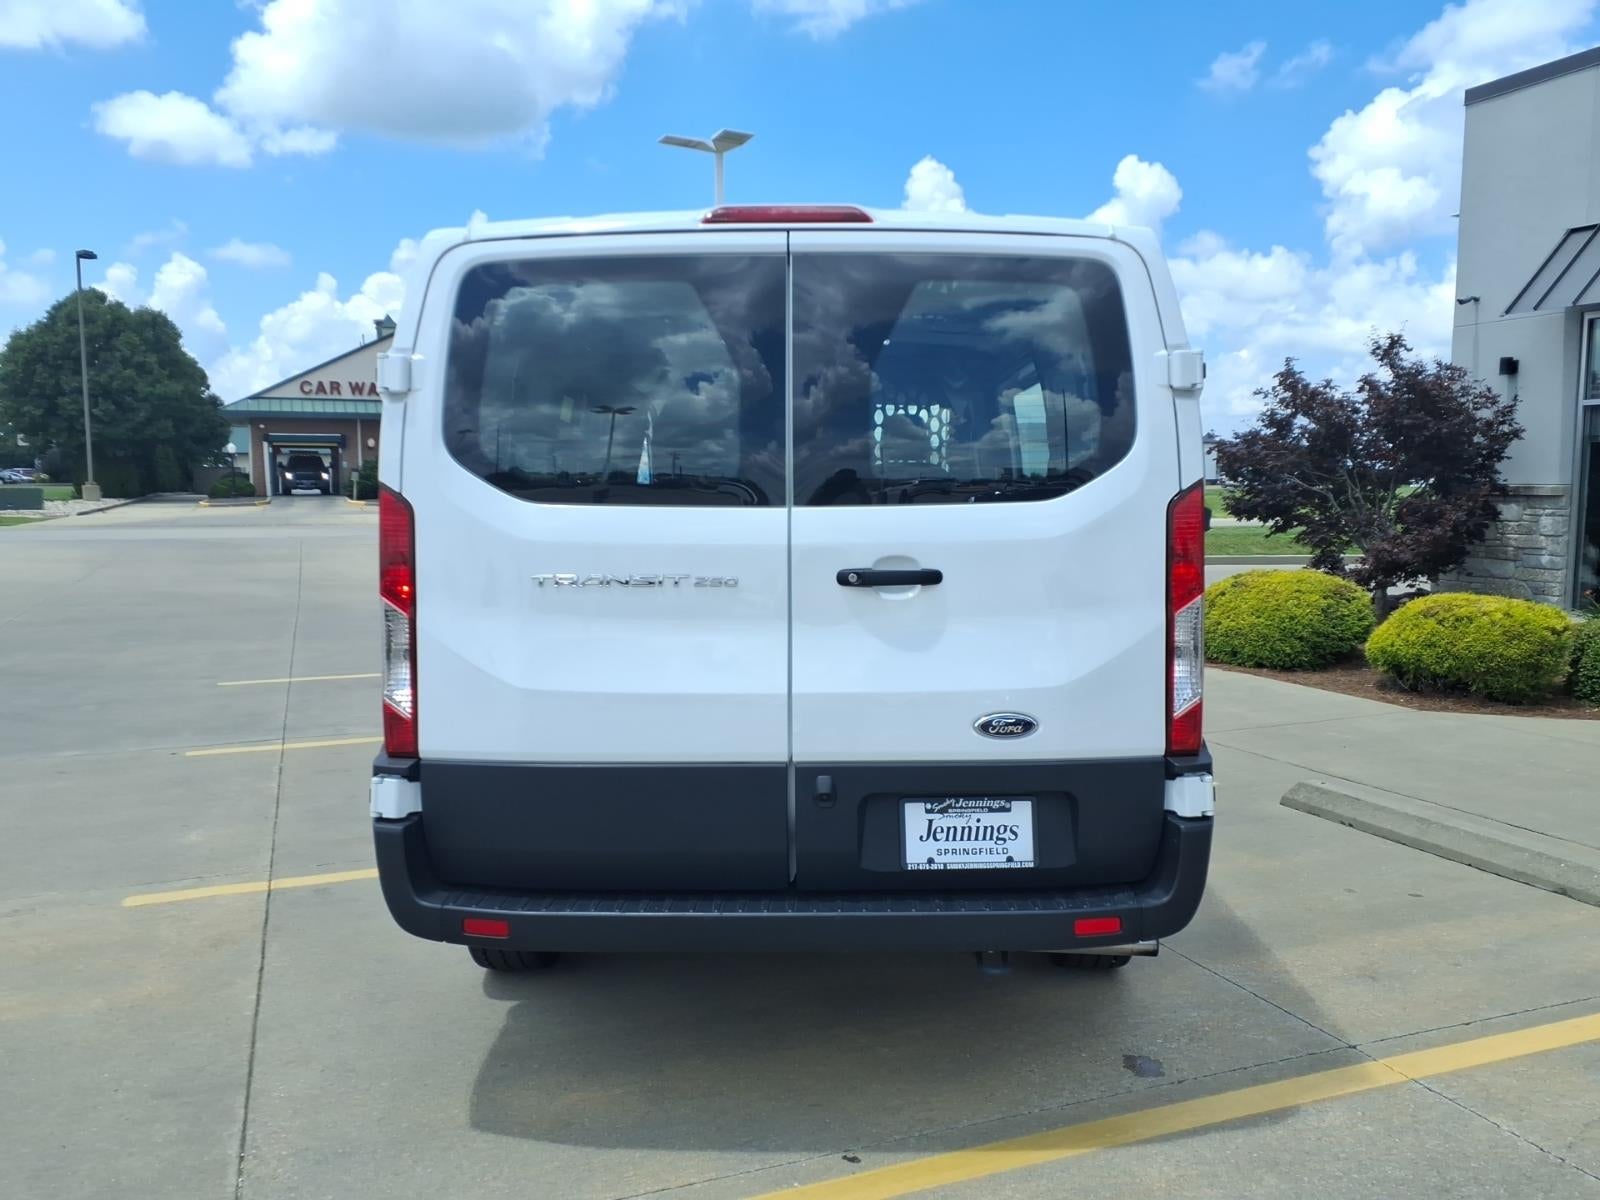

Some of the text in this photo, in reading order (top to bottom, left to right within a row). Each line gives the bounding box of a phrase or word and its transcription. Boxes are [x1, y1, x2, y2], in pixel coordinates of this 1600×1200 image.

[299, 380, 342, 396] CAR
[530, 573, 739, 588] TRANSIT 250
[988, 718, 1025, 734] Ford
[954, 797, 1007, 809] Jennings
[919, 817, 1020, 846] Jennings
[936, 847, 1009, 857] SPRINGFIELD
